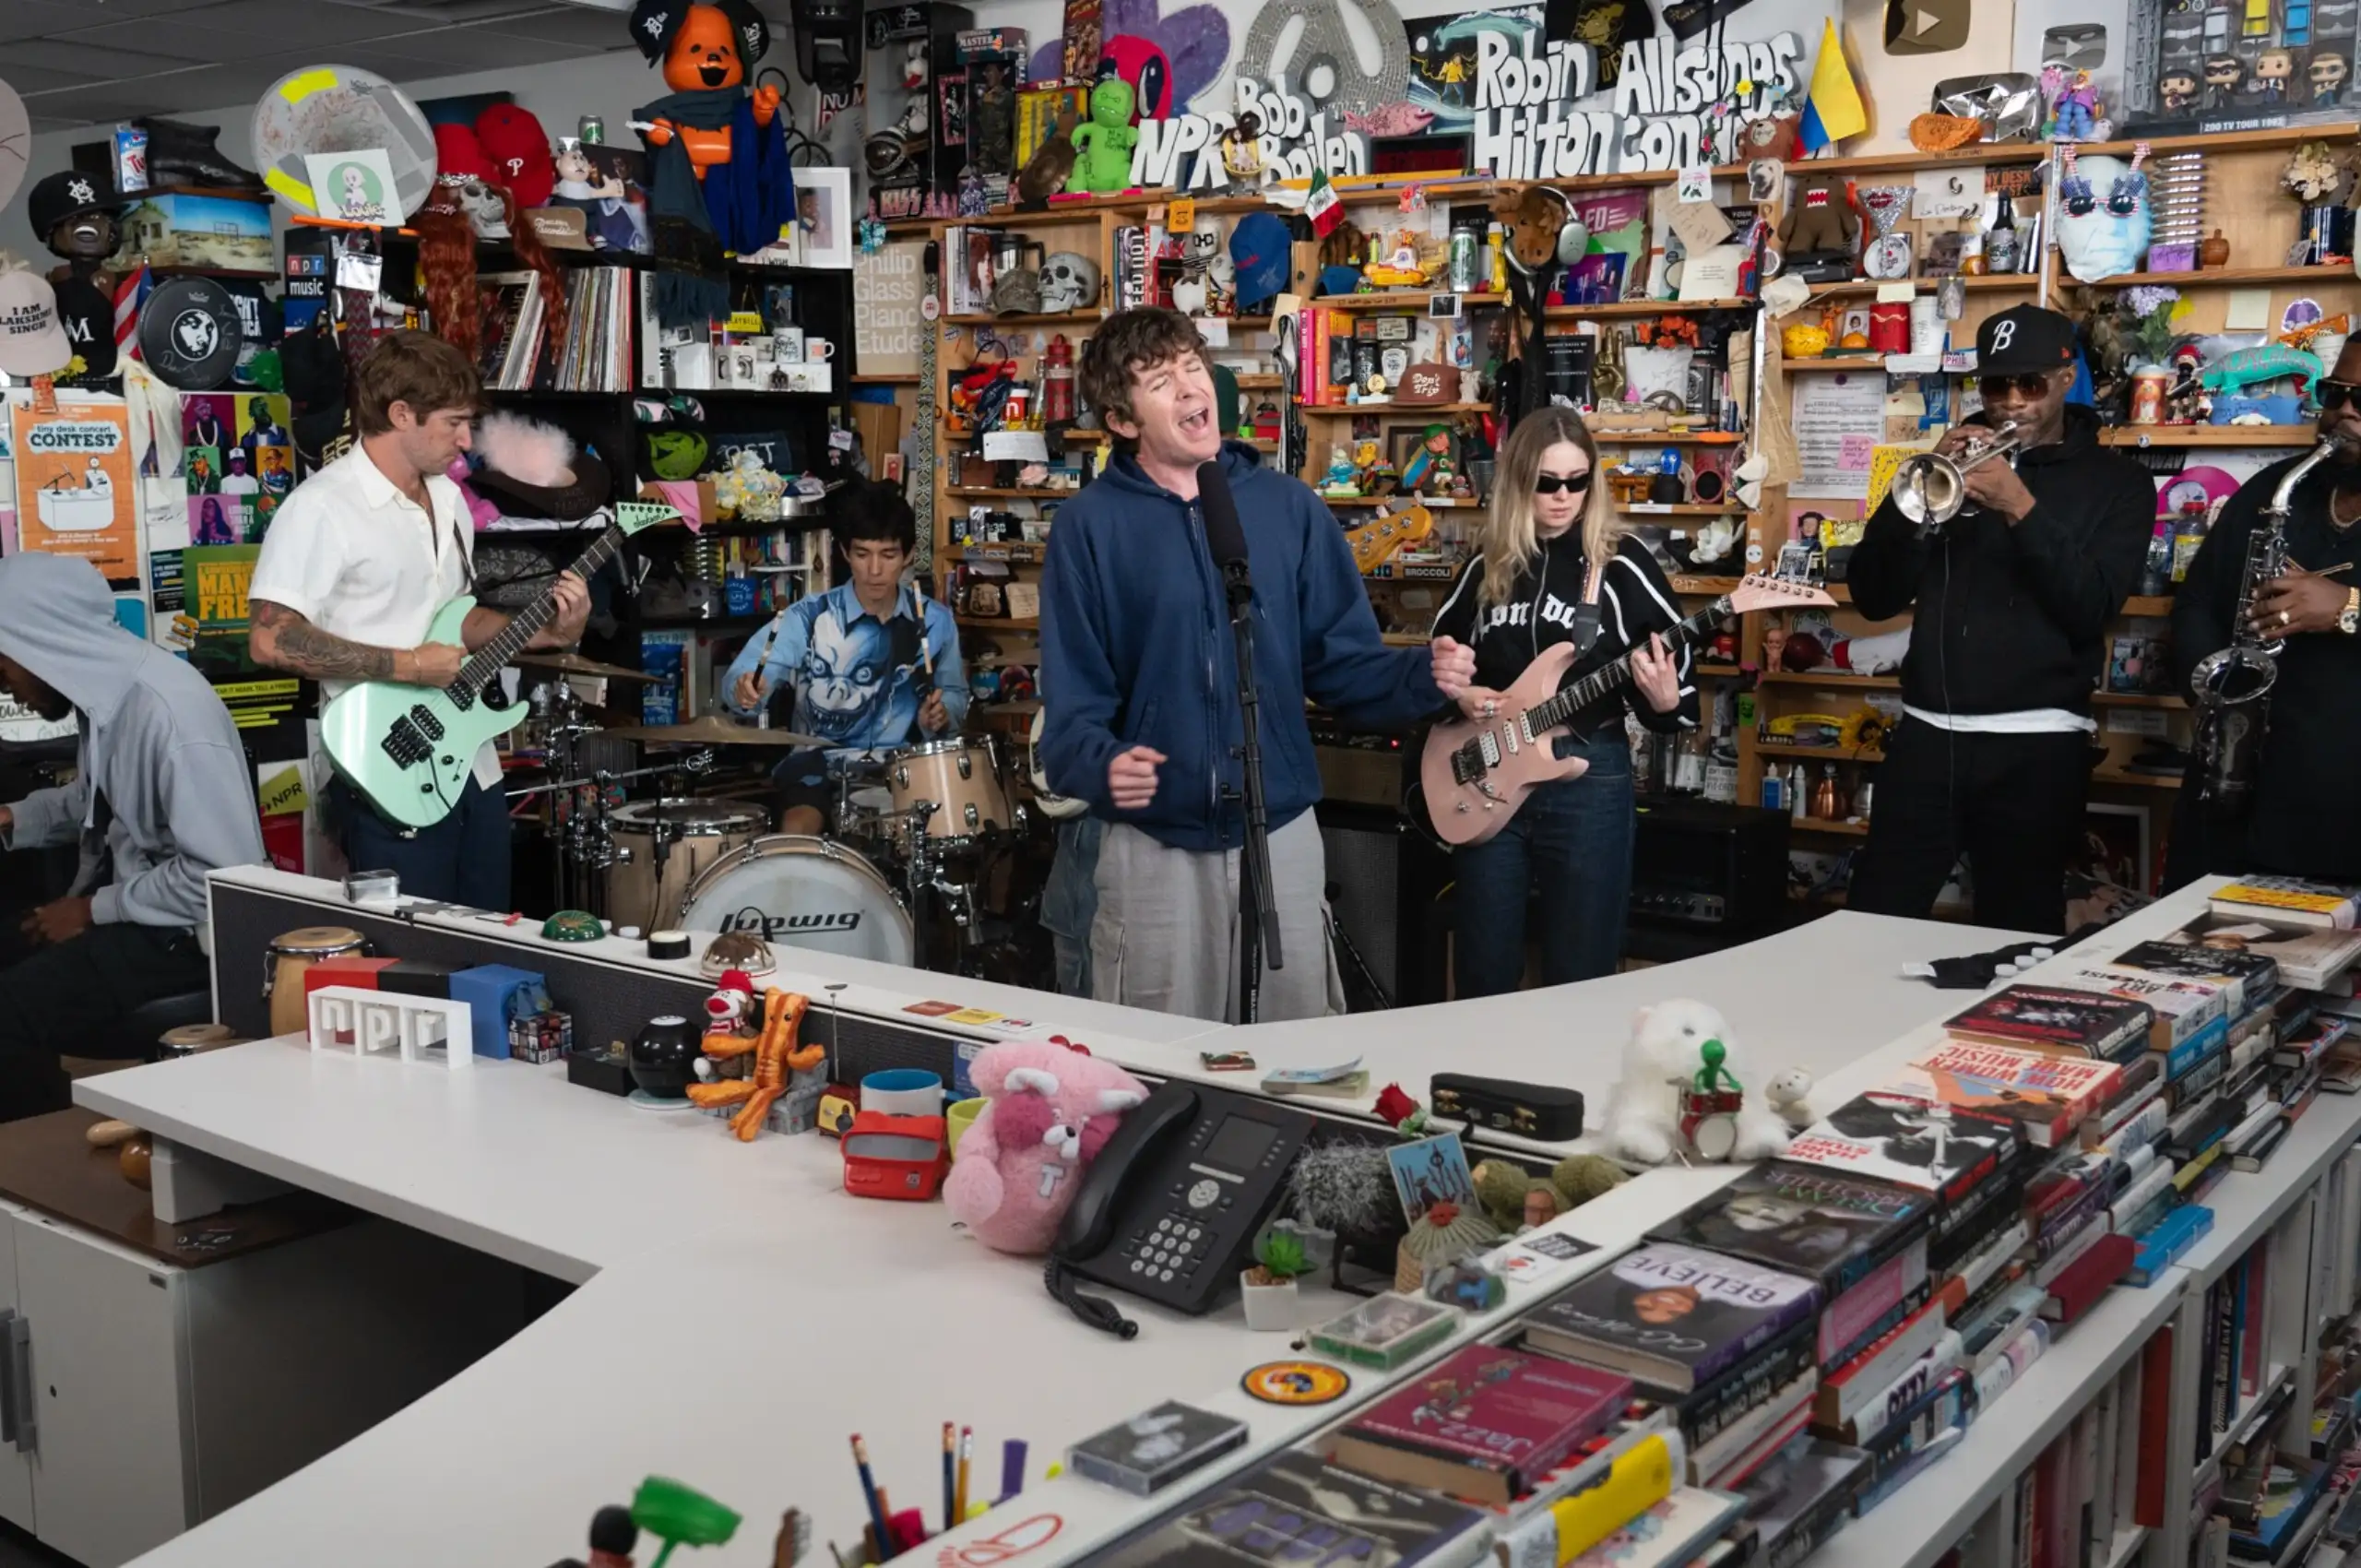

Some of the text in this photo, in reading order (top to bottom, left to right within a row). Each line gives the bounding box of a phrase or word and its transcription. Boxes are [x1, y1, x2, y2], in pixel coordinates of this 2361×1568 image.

[1476, 29, 1588, 109] Robin
[1236, 74, 1308, 138] Bob
[1128, 111, 1239, 188] NPR
[1476, 108, 1614, 180] Hilton
[880, 188, 922, 218] KISS
[290, 256, 322, 272] npr
[853, 248, 917, 279] Philip
[289, 278, 325, 296] music
[854, 277, 916, 302] Glass
[21, 303, 42, 315] AM
[9, 323, 47, 335] SINGH
[30, 434, 117, 448] CONTEST
[37, 424, 112, 436] tiny desk concert
[1405, 567, 1452, 577] BROCCOLI
[271, 782, 303, 808] NPR
[322, 998, 445, 1051] npr
[1924, 1055, 2086, 1092] HOW WOMEN
[1935, 1045, 2098, 1080] MADE MUSIC
[1629, 1256, 1777, 1304] BELIEVE
[1886, 1366, 1929, 1423] OZZY
[1437, 1421, 1535, 1451] Jazz
